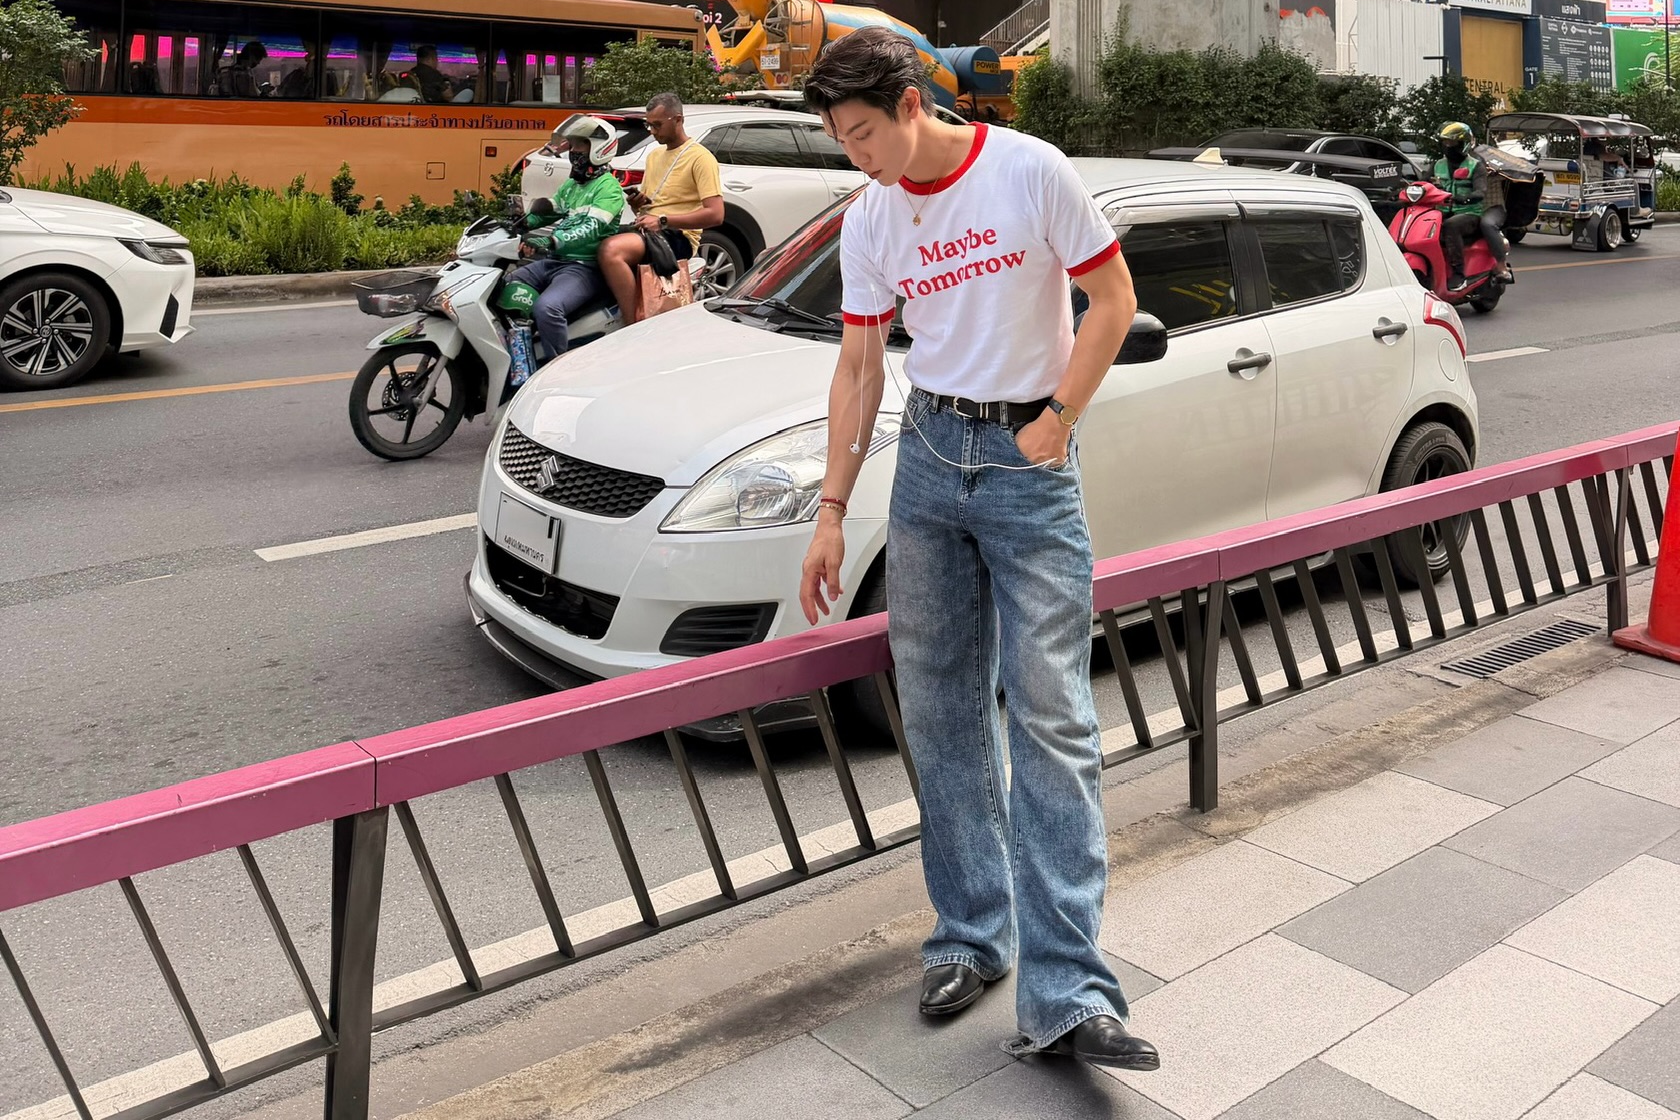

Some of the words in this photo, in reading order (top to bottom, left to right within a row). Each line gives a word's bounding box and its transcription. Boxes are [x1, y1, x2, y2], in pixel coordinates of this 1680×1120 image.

[976, 61, 999, 69] POWER
[1528, 72, 1534, 85] 1
[917, 228, 997, 267] Maybe
[511, 293, 533, 306] Grab
